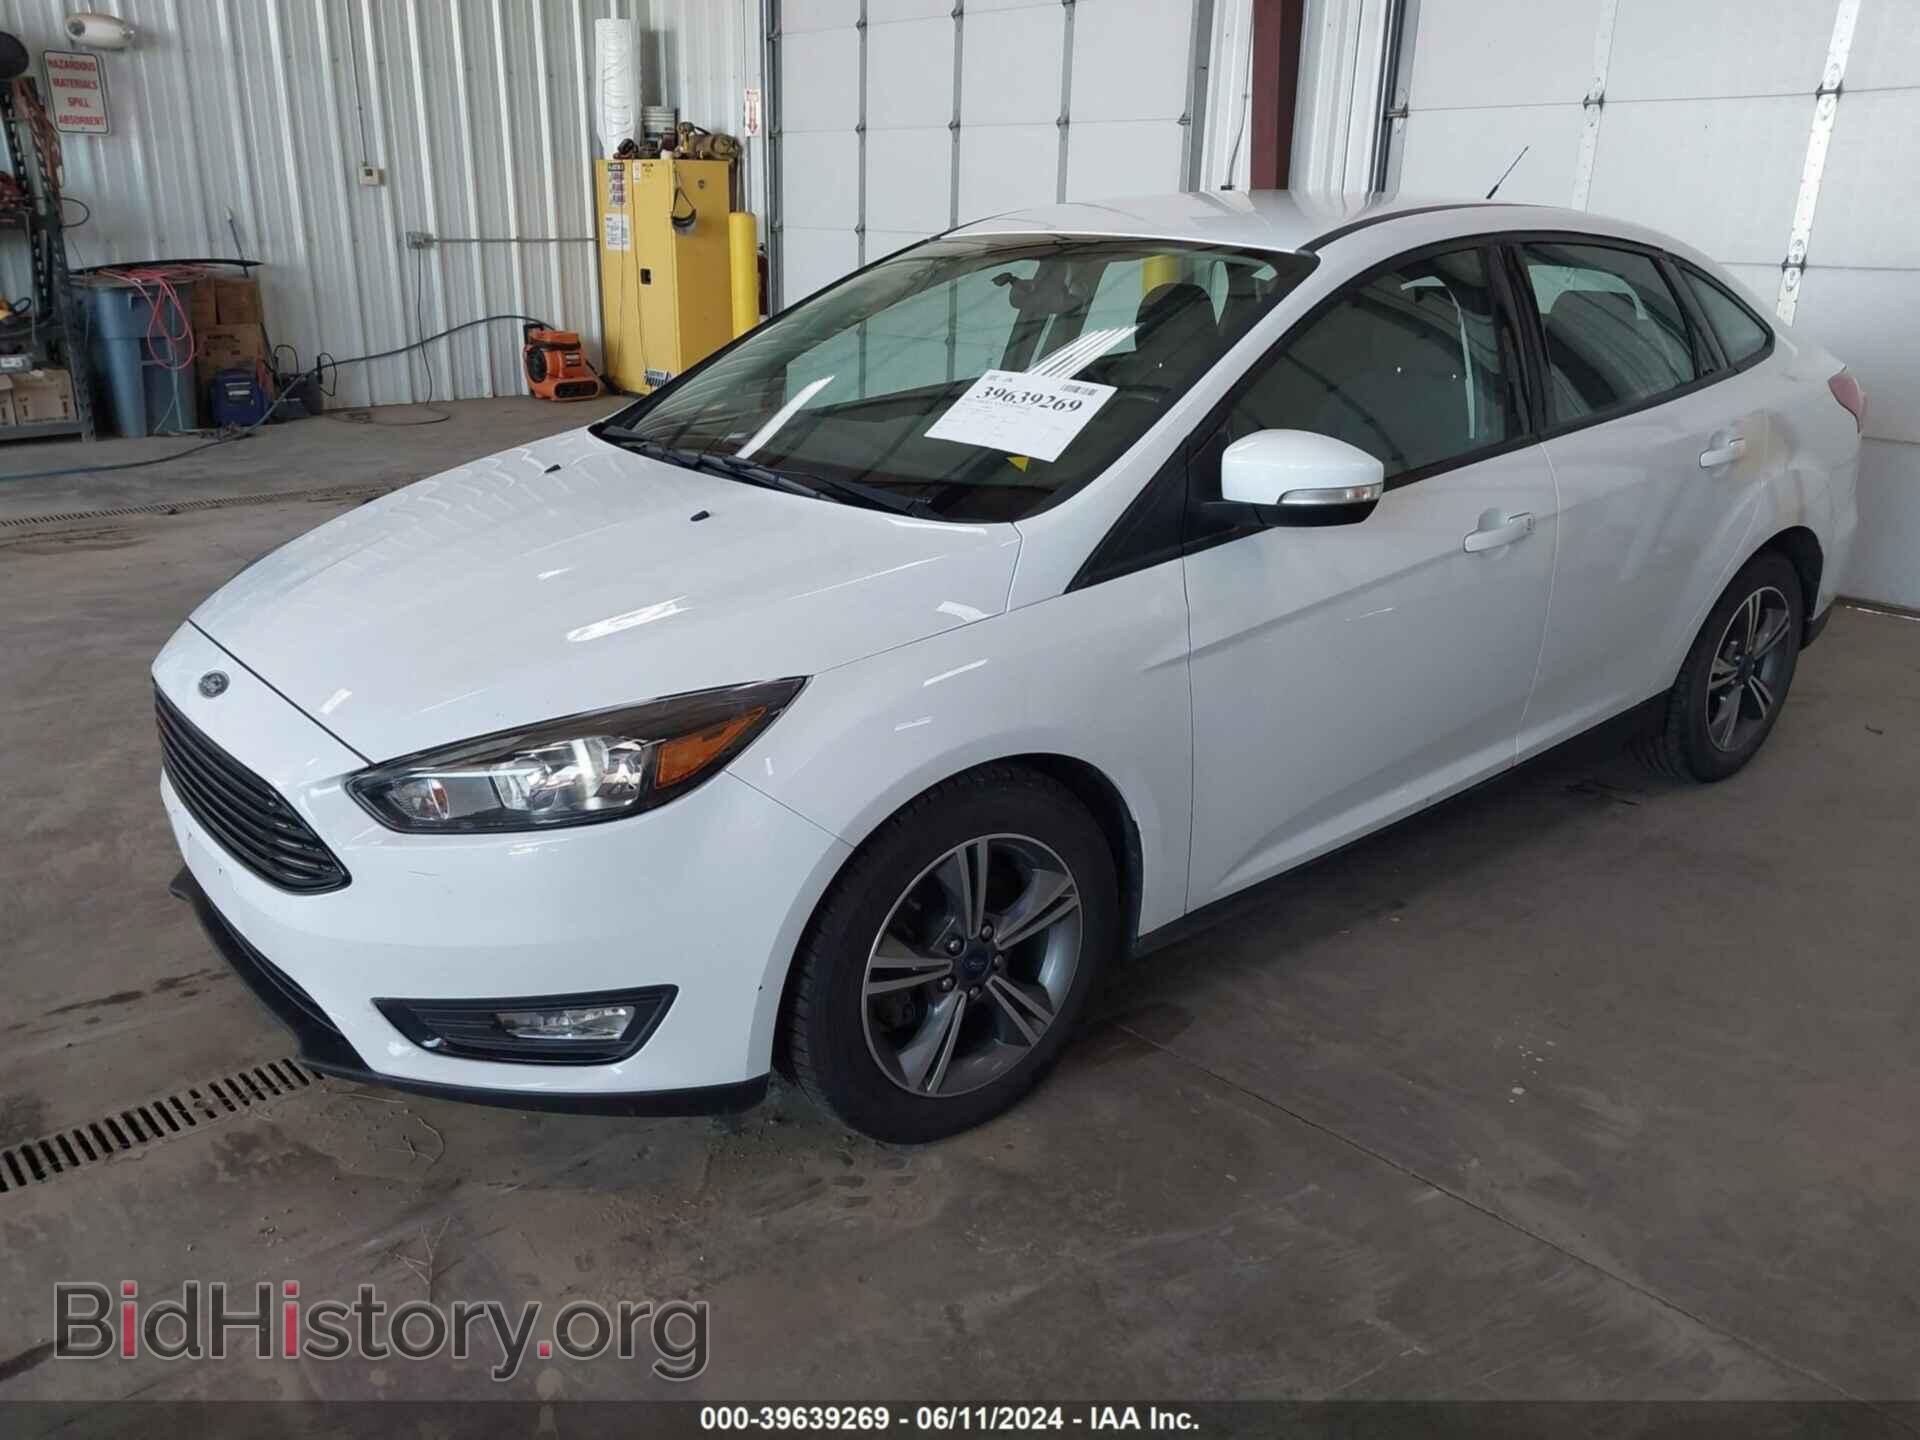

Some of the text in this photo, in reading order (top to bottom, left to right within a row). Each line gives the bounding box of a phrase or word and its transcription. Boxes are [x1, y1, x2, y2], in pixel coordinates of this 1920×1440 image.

[48, 59, 97, 72] HAZARDOUS
[53, 77, 98, 91] MATERIALS
[67, 96, 90, 108] SPILL
[58, 114, 105, 126] ABSORBENT
[976, 385, 1083, 413] 39639269
